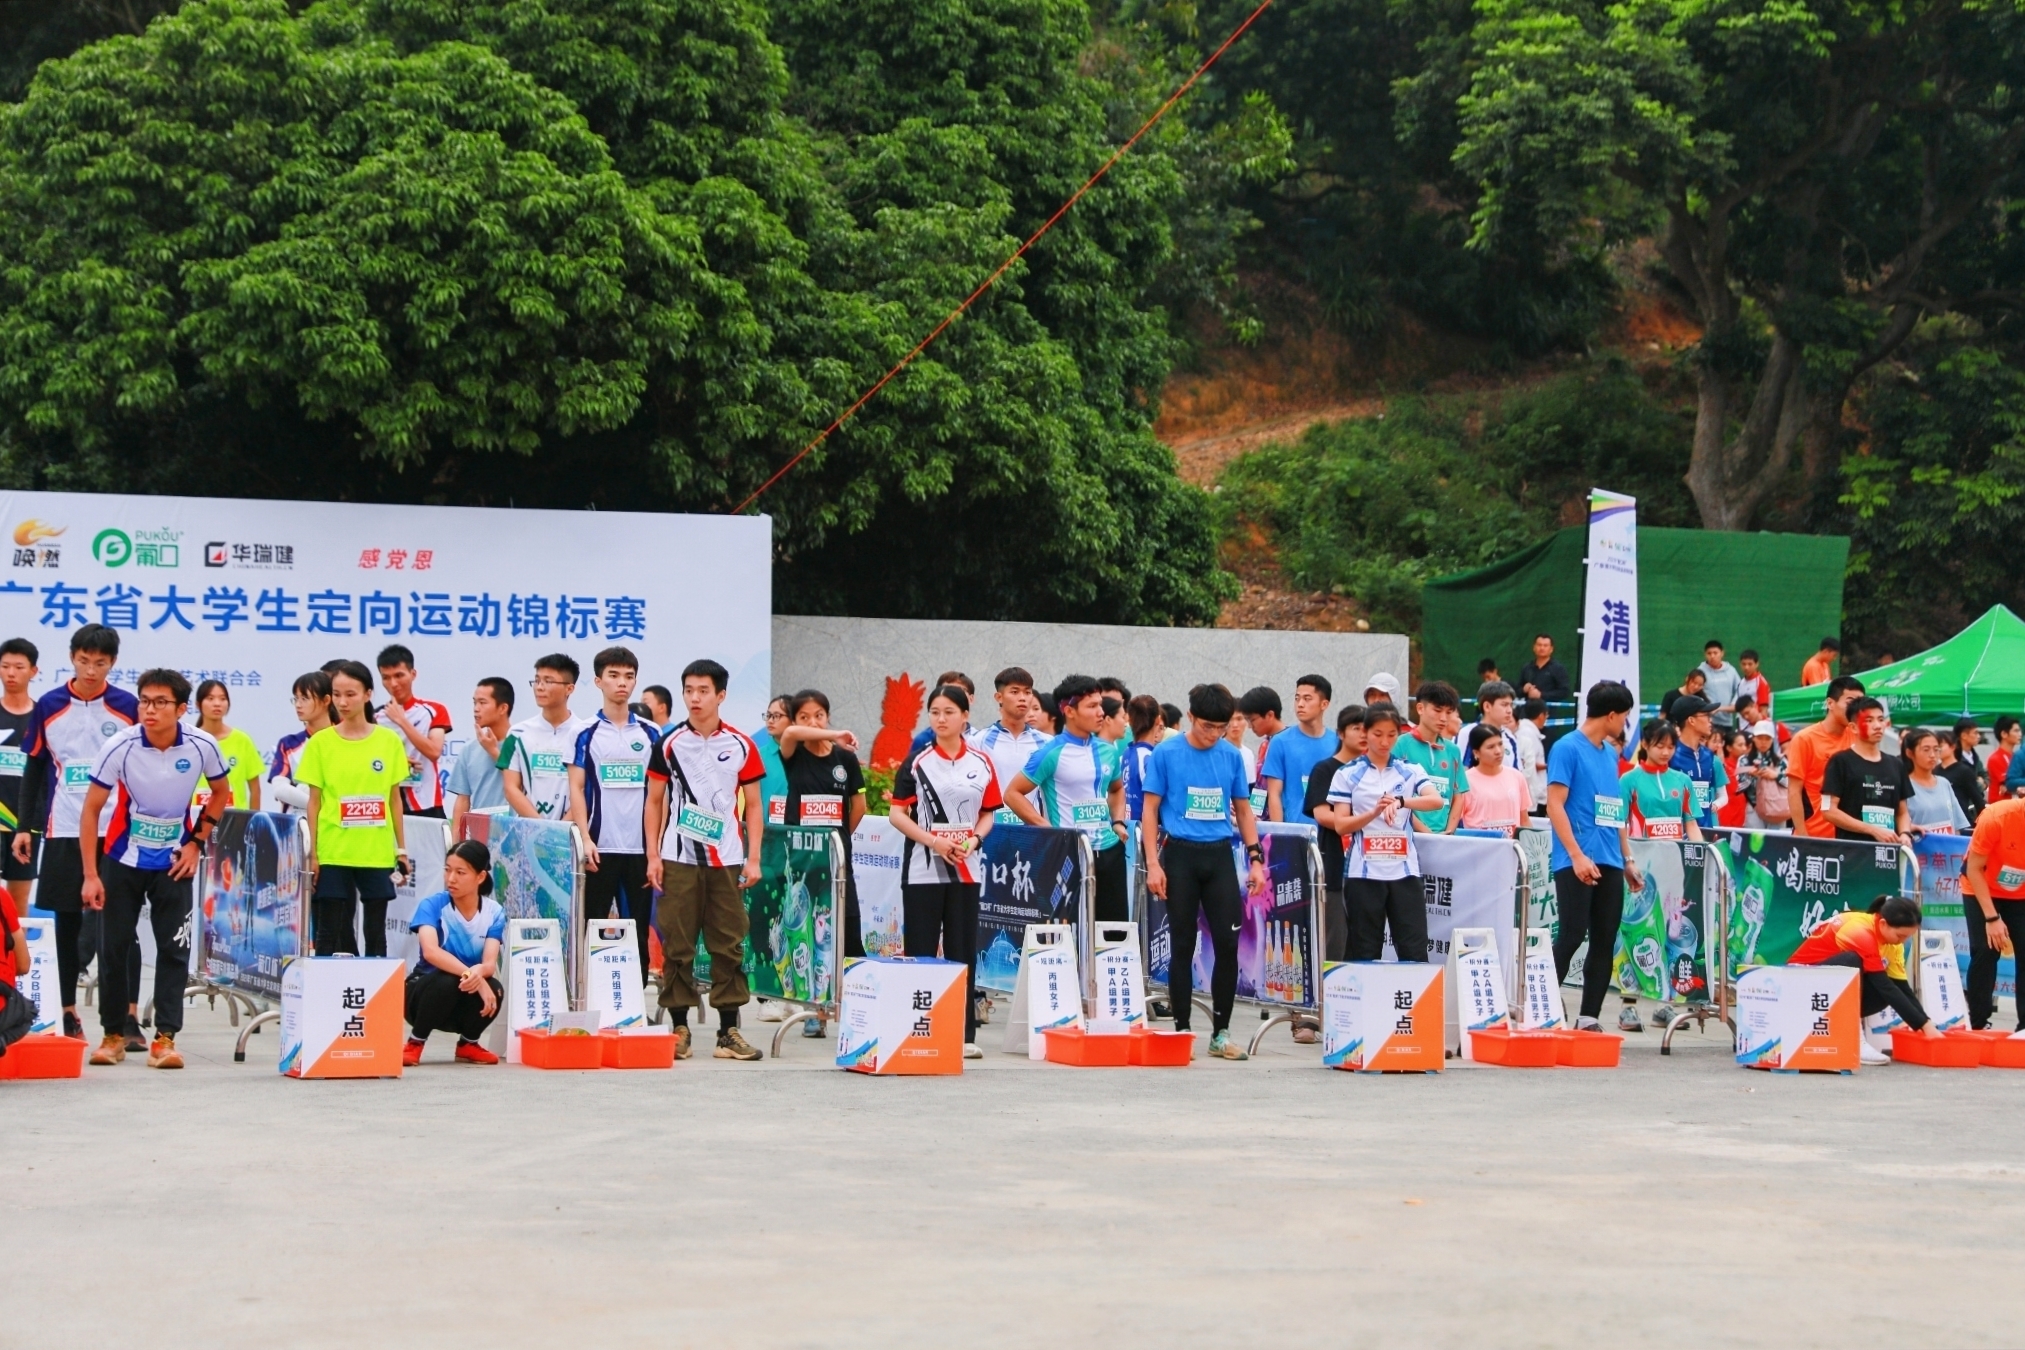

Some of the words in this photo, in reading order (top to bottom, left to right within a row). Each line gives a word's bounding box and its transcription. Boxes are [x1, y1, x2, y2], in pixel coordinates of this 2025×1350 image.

[135, 543, 179, 567] 葡口
[232, 543, 294, 564] 华瑞健
[358, 548, 433, 570] 感党恩
[0, 580, 647, 641] 广东省大学生定向运动锦标赛
[1, 753, 26, 766] 2104
[537, 754, 563, 767] 5103
[72, 766, 90, 780] 211
[606, 765, 639, 778] 51065
[346, 802, 381, 816] 22126
[805, 802, 838, 814] 52046
[1078, 807, 1106, 819] 31043
[1192, 796, 1222, 808] 31092
[1598, 803, 1620, 817] 41021
[138, 822, 175, 836] 21152
[685, 812, 719, 834] 51084
[1002, 813, 1023, 825] 311
[1650, 824, 1679, 836] 42033
[1369, 838, 1402, 850] 32123
[1684, 844, 1704, 860] 葡口
[1875, 846, 1896, 862] 葡口
[1805, 855, 1840, 883] 葡口
[1875, 862, 1897, 870] PUKOU
[1805, 882, 1818, 893] PU
[1820, 883, 1840, 895] KOU
[2003, 873, 2023, 885] 511
[603, 955, 627, 963] 短距离
[1678, 959, 1693, 983] 鲜
[525, 968, 536, 1020] 甲B组女子
[540, 968, 550, 1020] 乙B组女子
[611, 970, 622, 1011] 丙组男子
[1048, 972, 1059, 1011] 丙组女子
[1108, 967, 1118, 1016] 甲A组男子
[1120, 967, 1131, 1016] 乙A组男子
[1471, 969, 1484, 1016] 甲A组女子
[1483, 969, 1496, 1016] 乙A组女子
[1528, 974, 1540, 1021] 甲B组男子
[1539, 974, 1551, 1021] 乙B组男子
[1938, 974, 1949, 1012] 丙组男子
[342, 987, 365, 1037] 起点
[911, 989, 933, 1037] 起点
[1394, 990, 1413, 1035] 起点
[1811, 992, 1830, 1036] 起点
